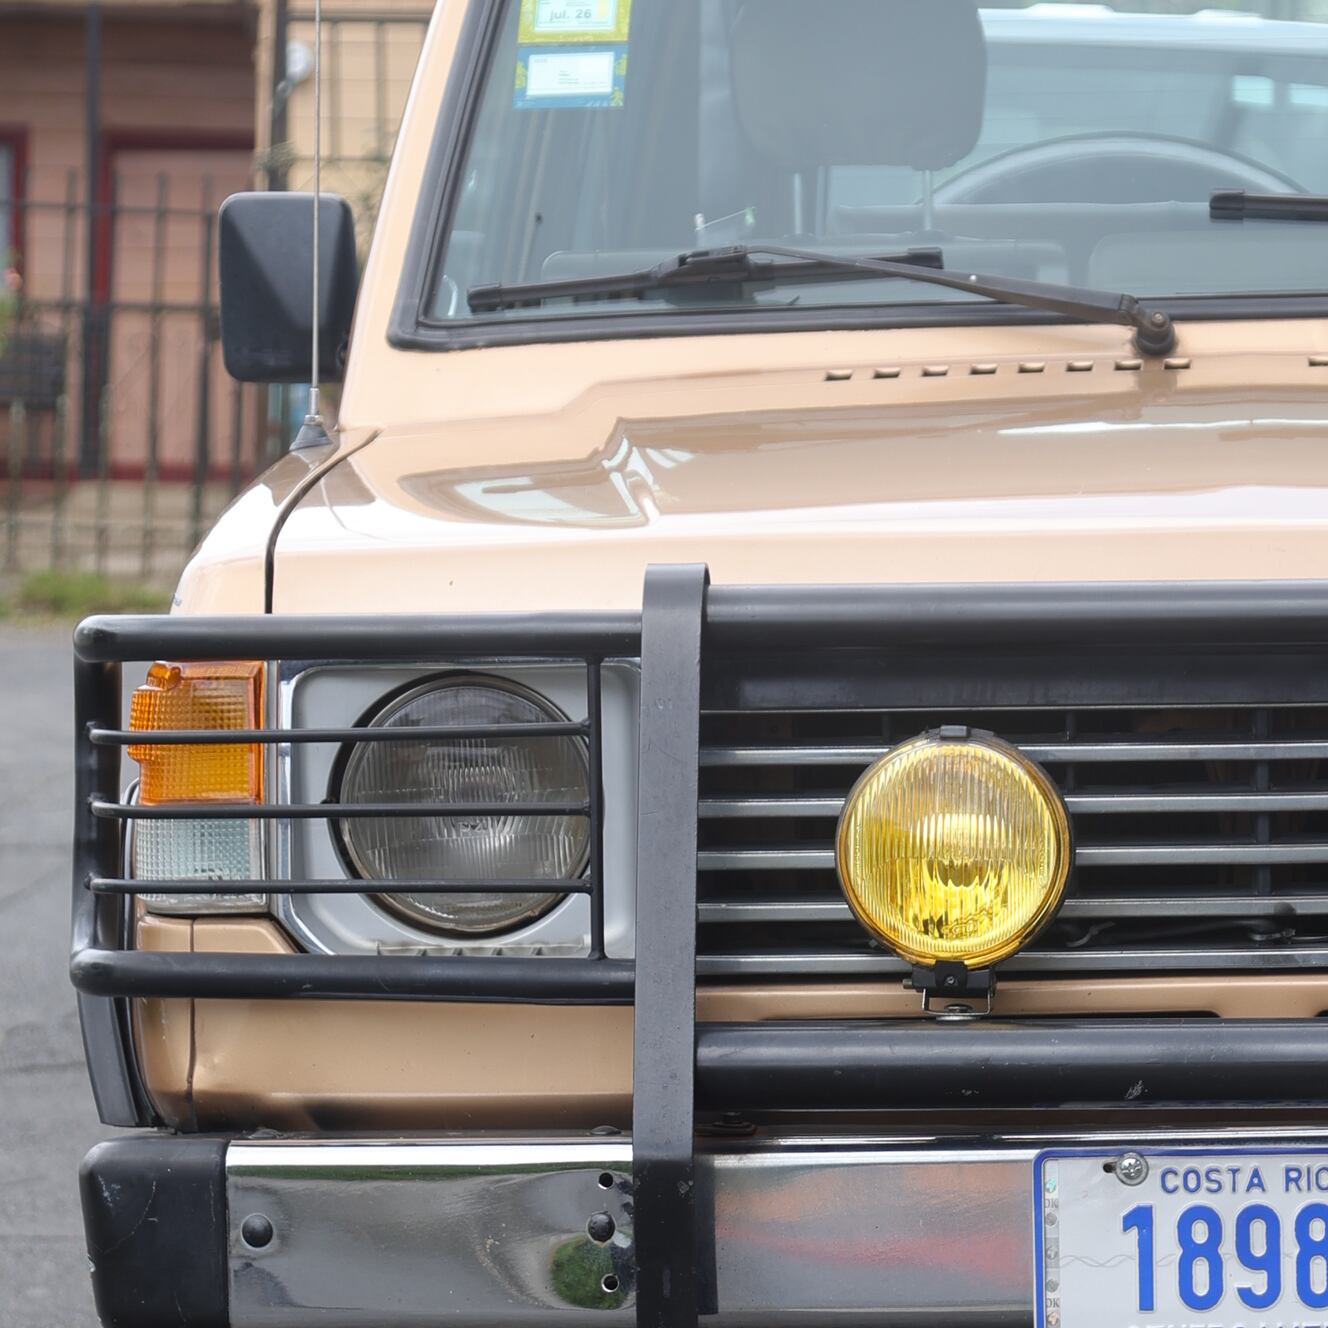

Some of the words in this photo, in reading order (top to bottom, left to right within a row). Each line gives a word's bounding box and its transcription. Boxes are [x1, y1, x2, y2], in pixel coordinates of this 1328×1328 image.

[549, 9, 570, 22] jul.
[575, 8, 592, 19] 26
[1160, 1166, 1267, 1194] COSTA
